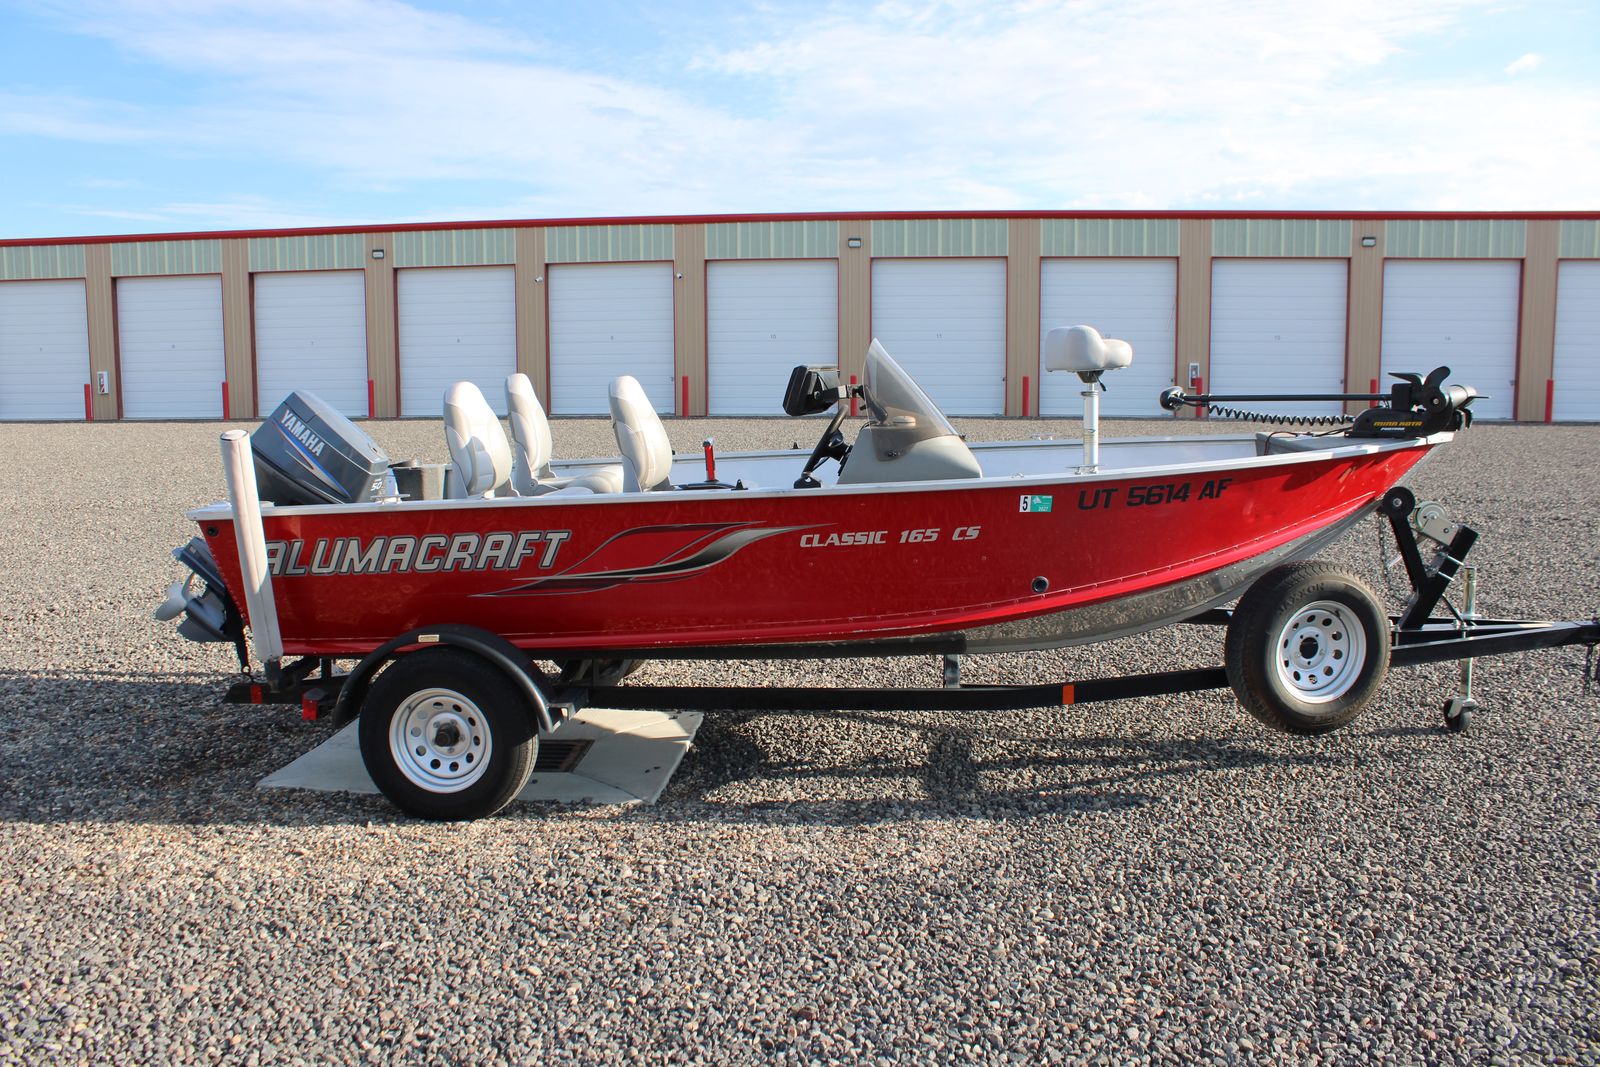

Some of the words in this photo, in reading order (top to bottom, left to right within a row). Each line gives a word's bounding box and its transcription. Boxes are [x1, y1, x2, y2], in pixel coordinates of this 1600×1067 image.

[280, 409, 325, 457] YAMAHA
[370, 481, 382, 491] 50
[1077, 488, 1118, 510] UT
[1126, 482, 1191, 507] 5614
[1198, 478, 1233, 501] AF
[1022, 496, 1028, 511] 5
[800, 530, 888, 548] CLASSIC
[899, 528, 941, 544] 165
[951, 525, 982, 541] CS
[266, 530, 572, 576] ALUMACRAFT
